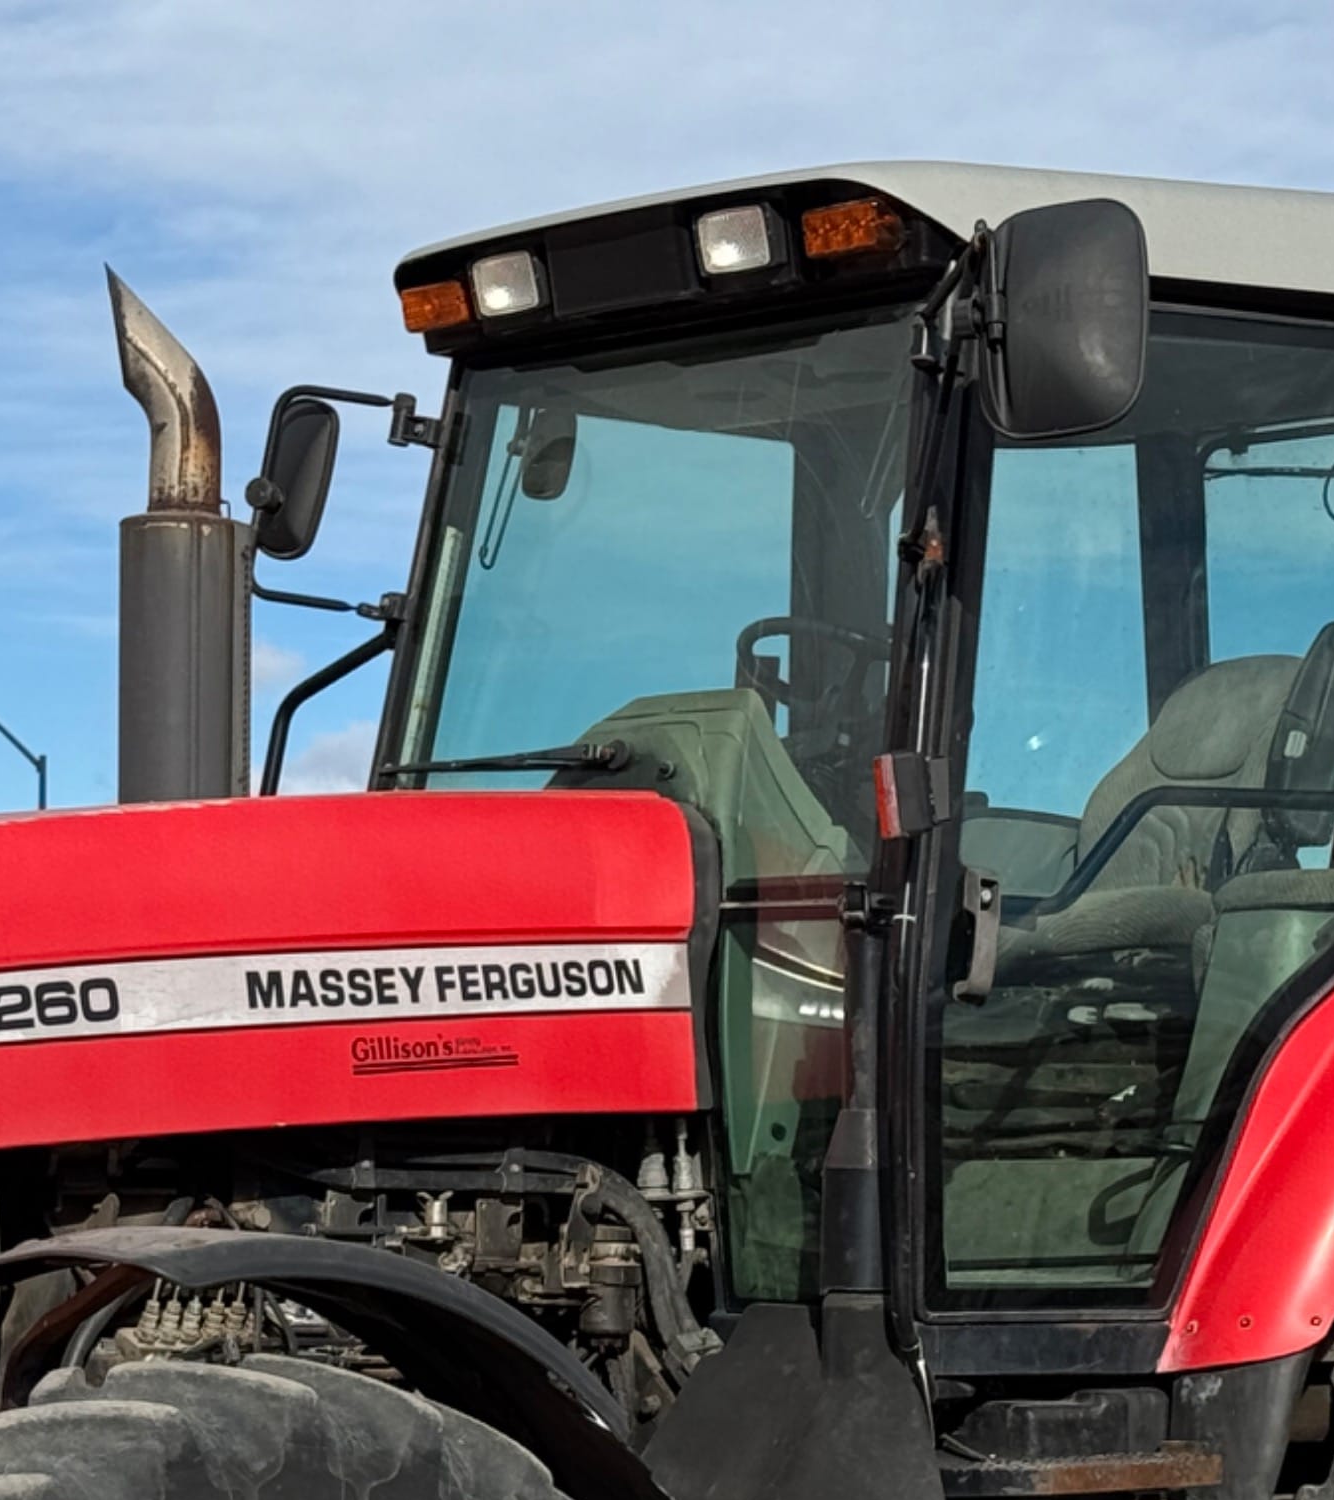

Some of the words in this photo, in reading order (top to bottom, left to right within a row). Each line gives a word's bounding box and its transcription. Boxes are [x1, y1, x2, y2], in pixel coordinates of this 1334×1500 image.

[245, 966, 425, 1009] MASSEY
[436, 958, 645, 1002] FERGUSON
[351, 1034, 454, 1062] Gillison's
